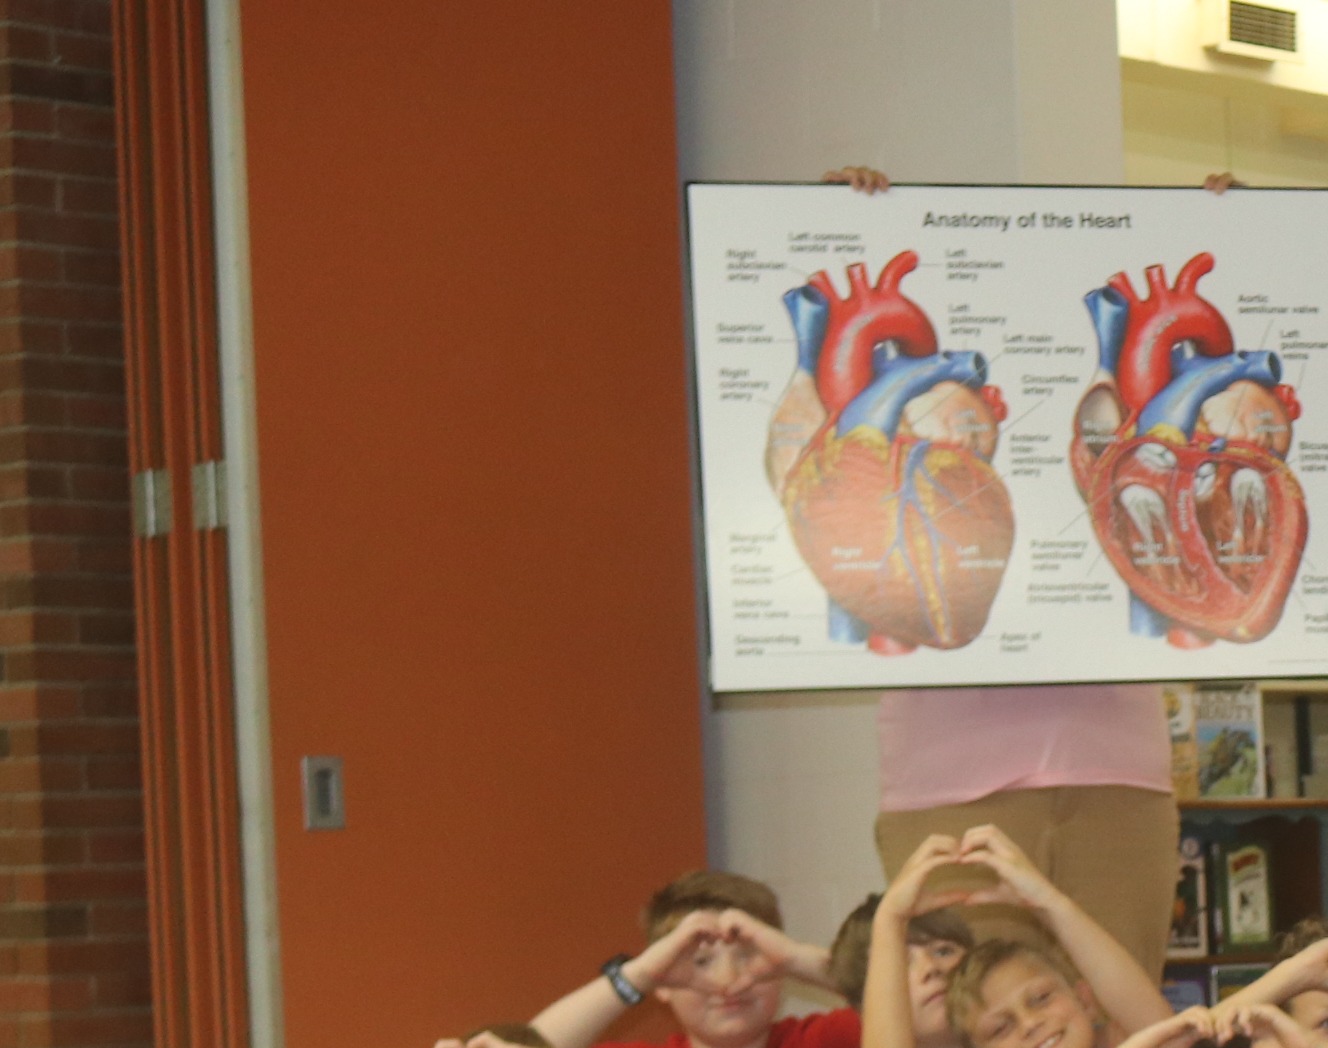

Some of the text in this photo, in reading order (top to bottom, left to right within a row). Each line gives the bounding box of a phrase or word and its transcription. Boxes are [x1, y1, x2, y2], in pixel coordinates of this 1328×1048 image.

[922, 211, 1132, 231] Anatomy of the Heart
